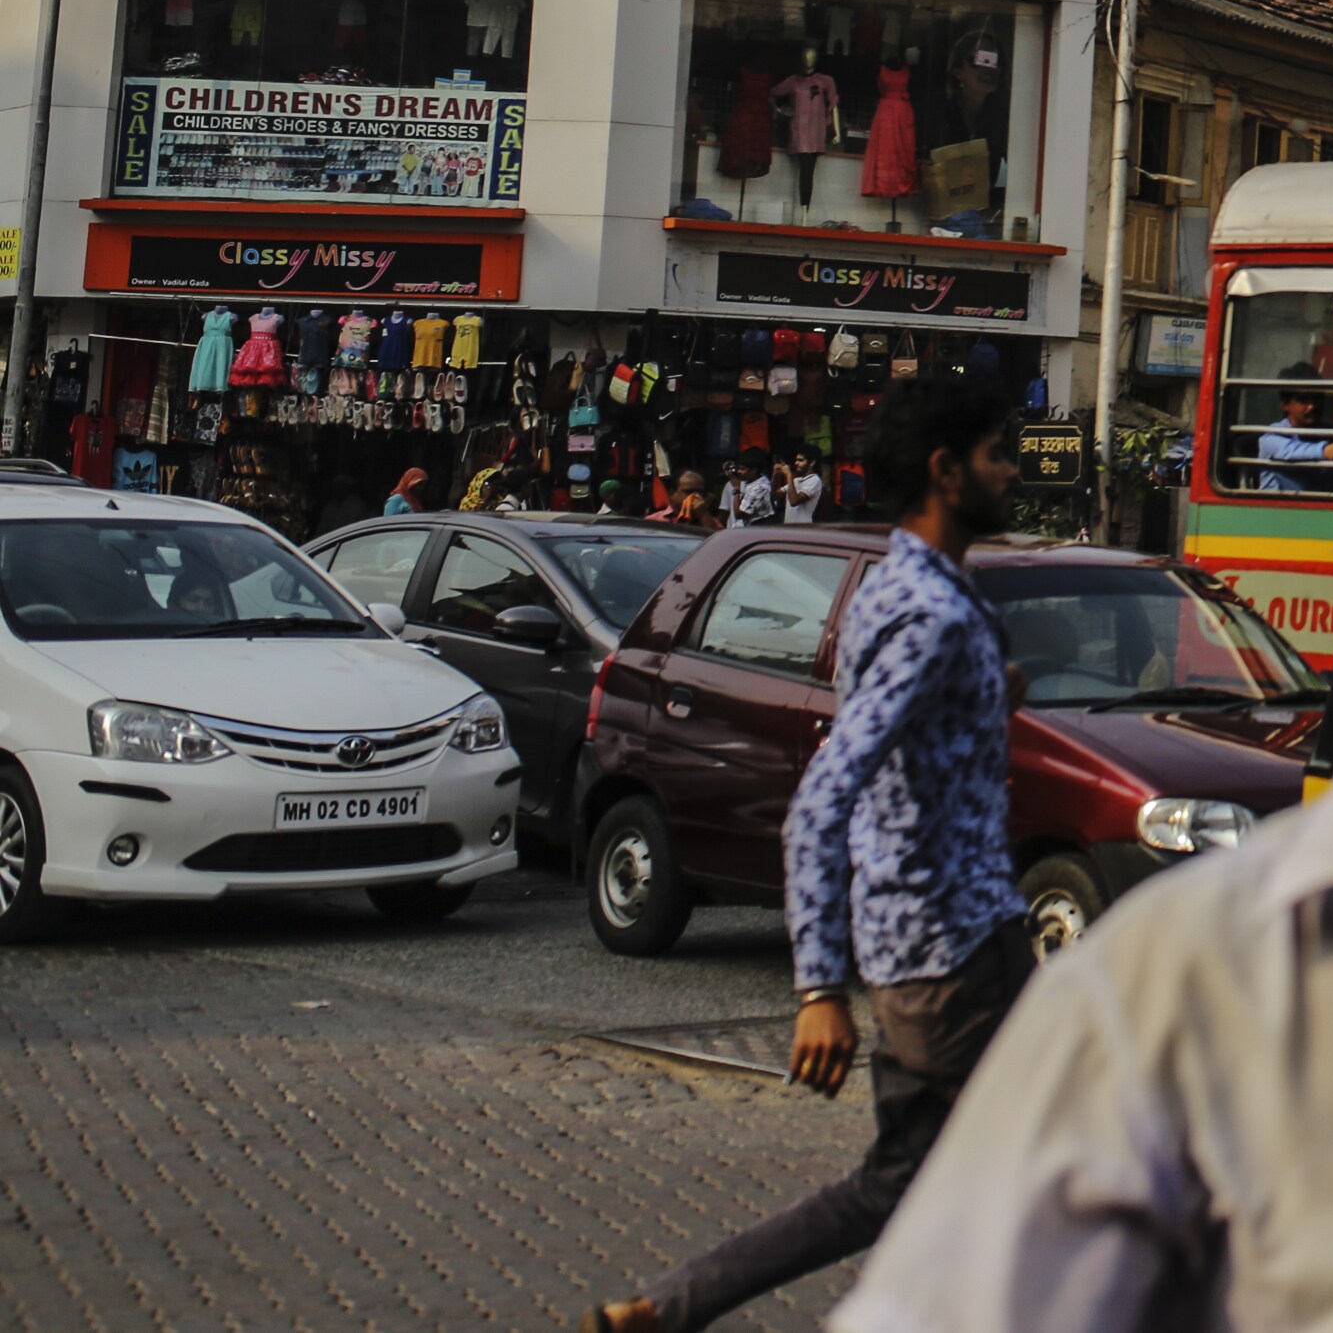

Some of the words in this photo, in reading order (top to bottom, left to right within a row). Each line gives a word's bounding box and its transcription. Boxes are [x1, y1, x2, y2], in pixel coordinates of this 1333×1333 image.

[165, 87, 362, 118] CHILDREN'S
[375, 94, 494, 121] DREAM
[123, 91, 151, 181] SALE
[173, 115, 268, 133] CHILDREN'S
[272, 118, 327, 134] SHOES
[332, 120, 343, 134] &
[349, 121, 400, 138] FANCY
[404, 124, 479, 140] DRESSES
[496, 105, 525, 195] SALE
[131, 278, 156, 286] Owner
[189, 279, 210, 287] Gada
[218, 241, 311, 289] Classy
[313, 243, 396, 291] Missy
[799, 260, 879, 307] Classy
[883, 266, 956, 312] Missy
[283, 801, 311, 822] MH
[317, 800, 339, 820] 02
[346, 799, 370, 819] CD
[376, 796, 418, 817] 4901
